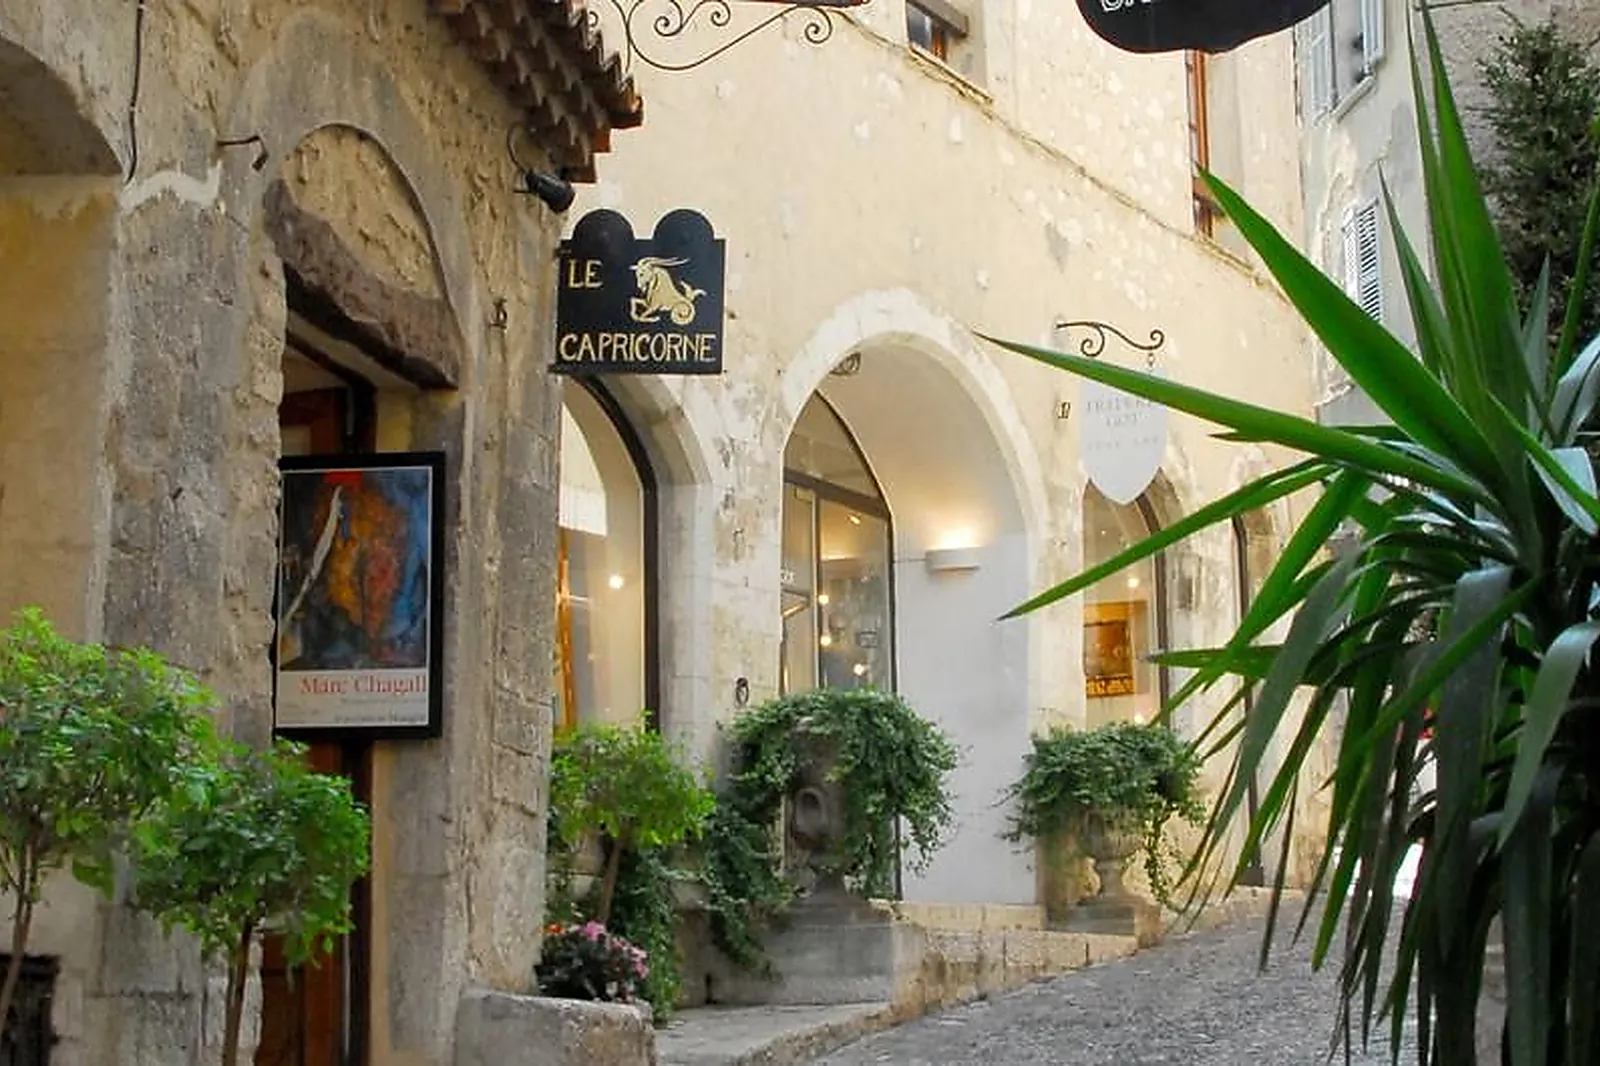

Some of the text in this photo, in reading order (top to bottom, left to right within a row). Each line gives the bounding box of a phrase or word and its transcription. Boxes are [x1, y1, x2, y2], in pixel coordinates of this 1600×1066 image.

[569, 259, 603, 288] LE
[559, 333, 715, 362] CAPRICORNE
[300, 675, 425, 695] Marc Chagall
